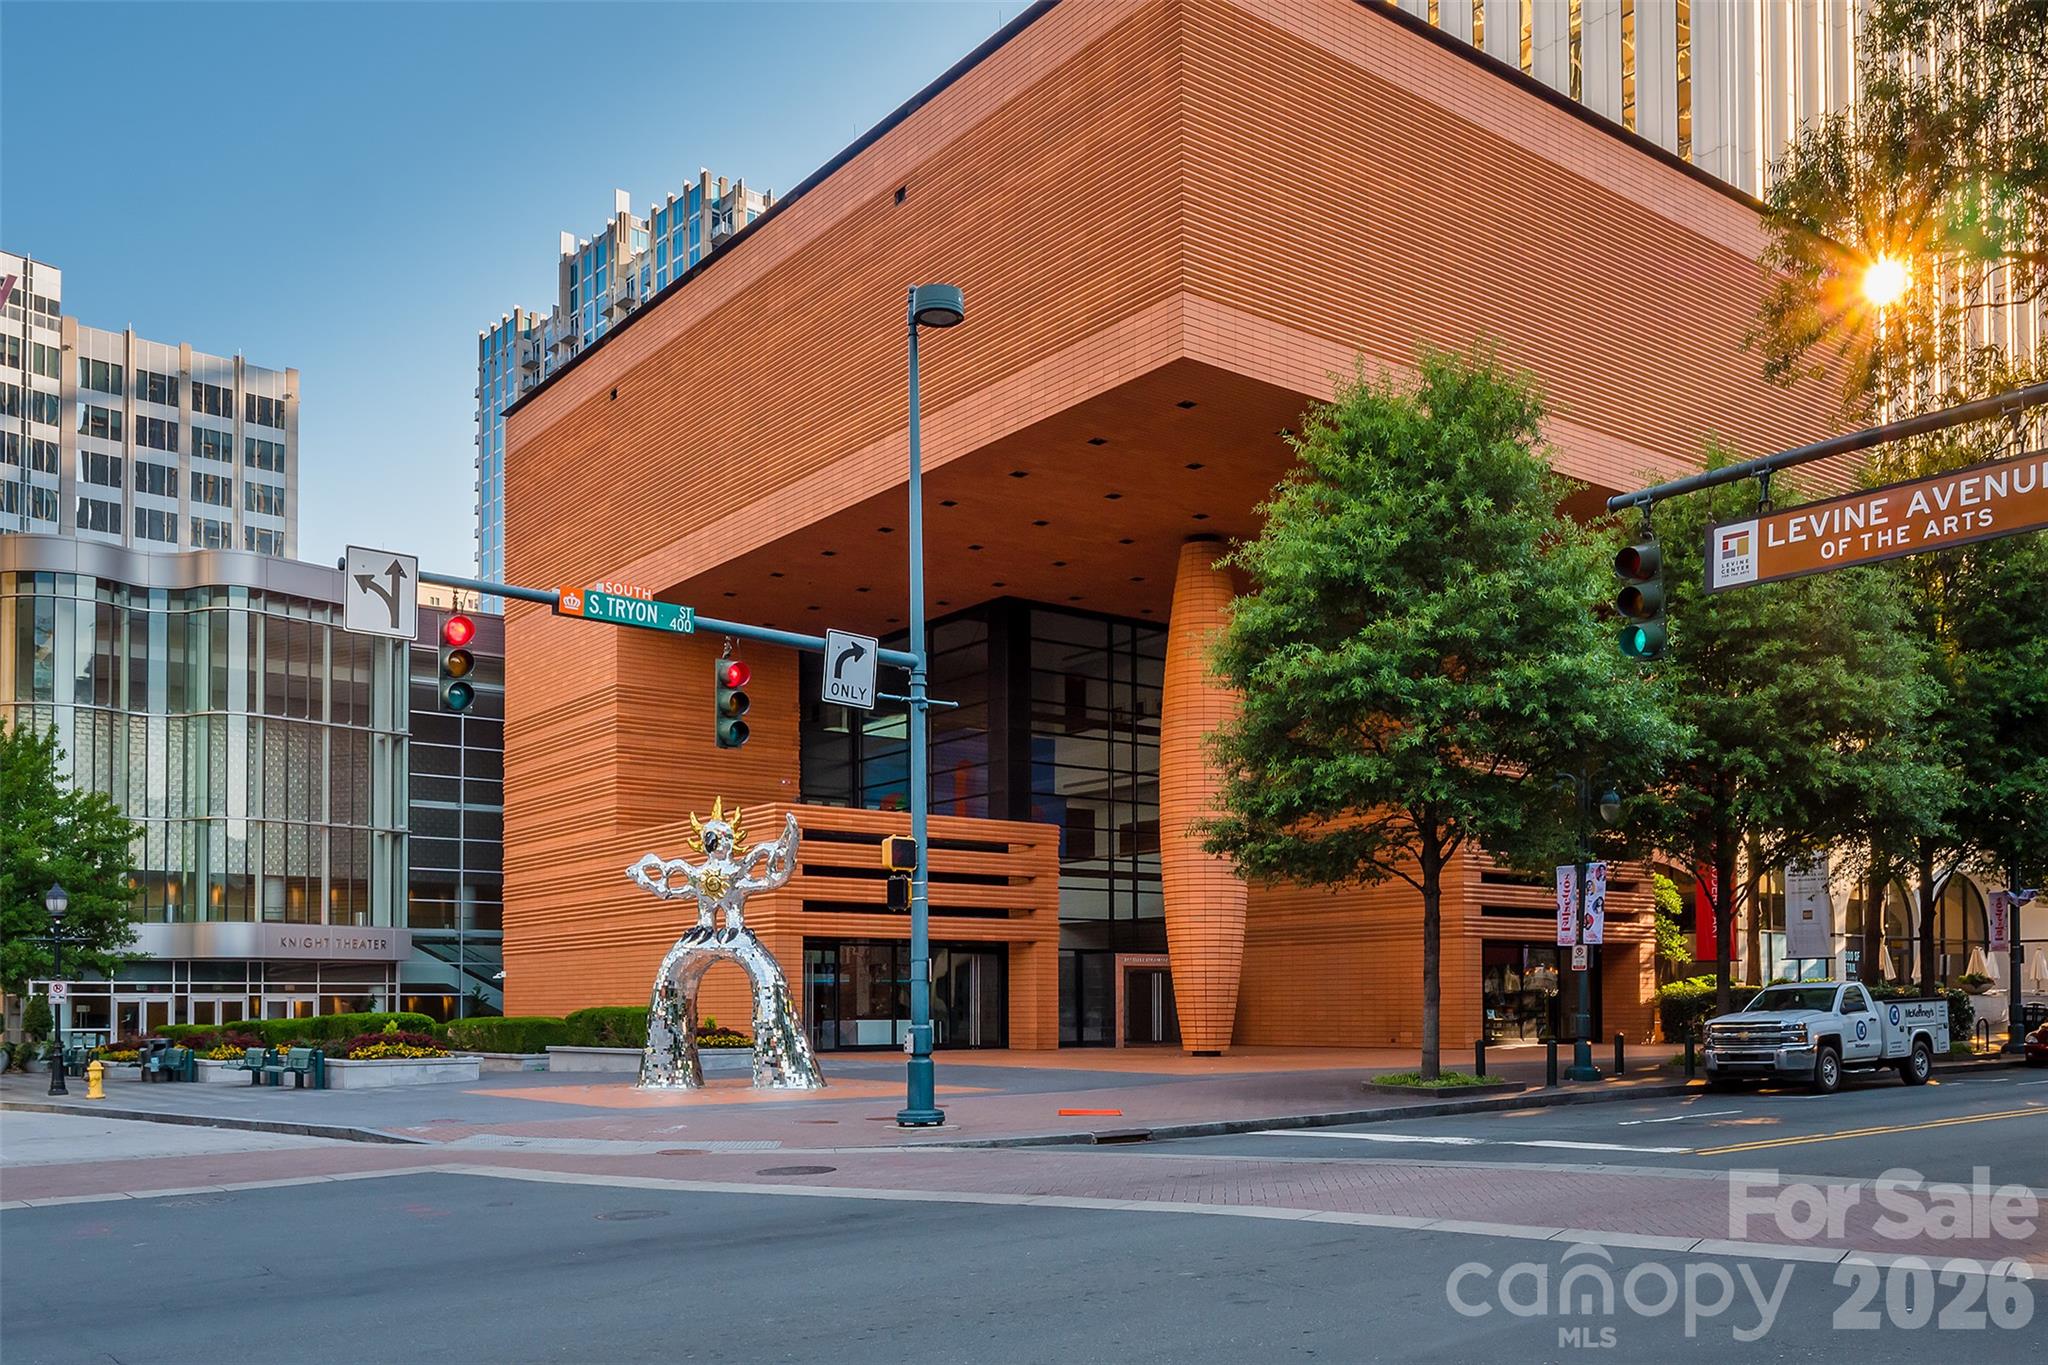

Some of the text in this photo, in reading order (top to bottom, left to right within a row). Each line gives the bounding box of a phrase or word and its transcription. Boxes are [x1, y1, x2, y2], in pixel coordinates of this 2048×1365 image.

[1767, 461, 2048, 548] LEVINE AVENU
[1820, 508, 1994, 560] OF THE ARTS
[1721, 559, 1749, 569] LEVINE
[1721, 564, 1749, 574] CENTER
[605, 582, 652, 600] SOUTH
[589, 594, 692, 624] S. TRYON ST
[669, 618, 692, 632] 400
[831, 682, 867, 700] ONLY
[280, 937, 387, 950] KNIGHT THEATER
